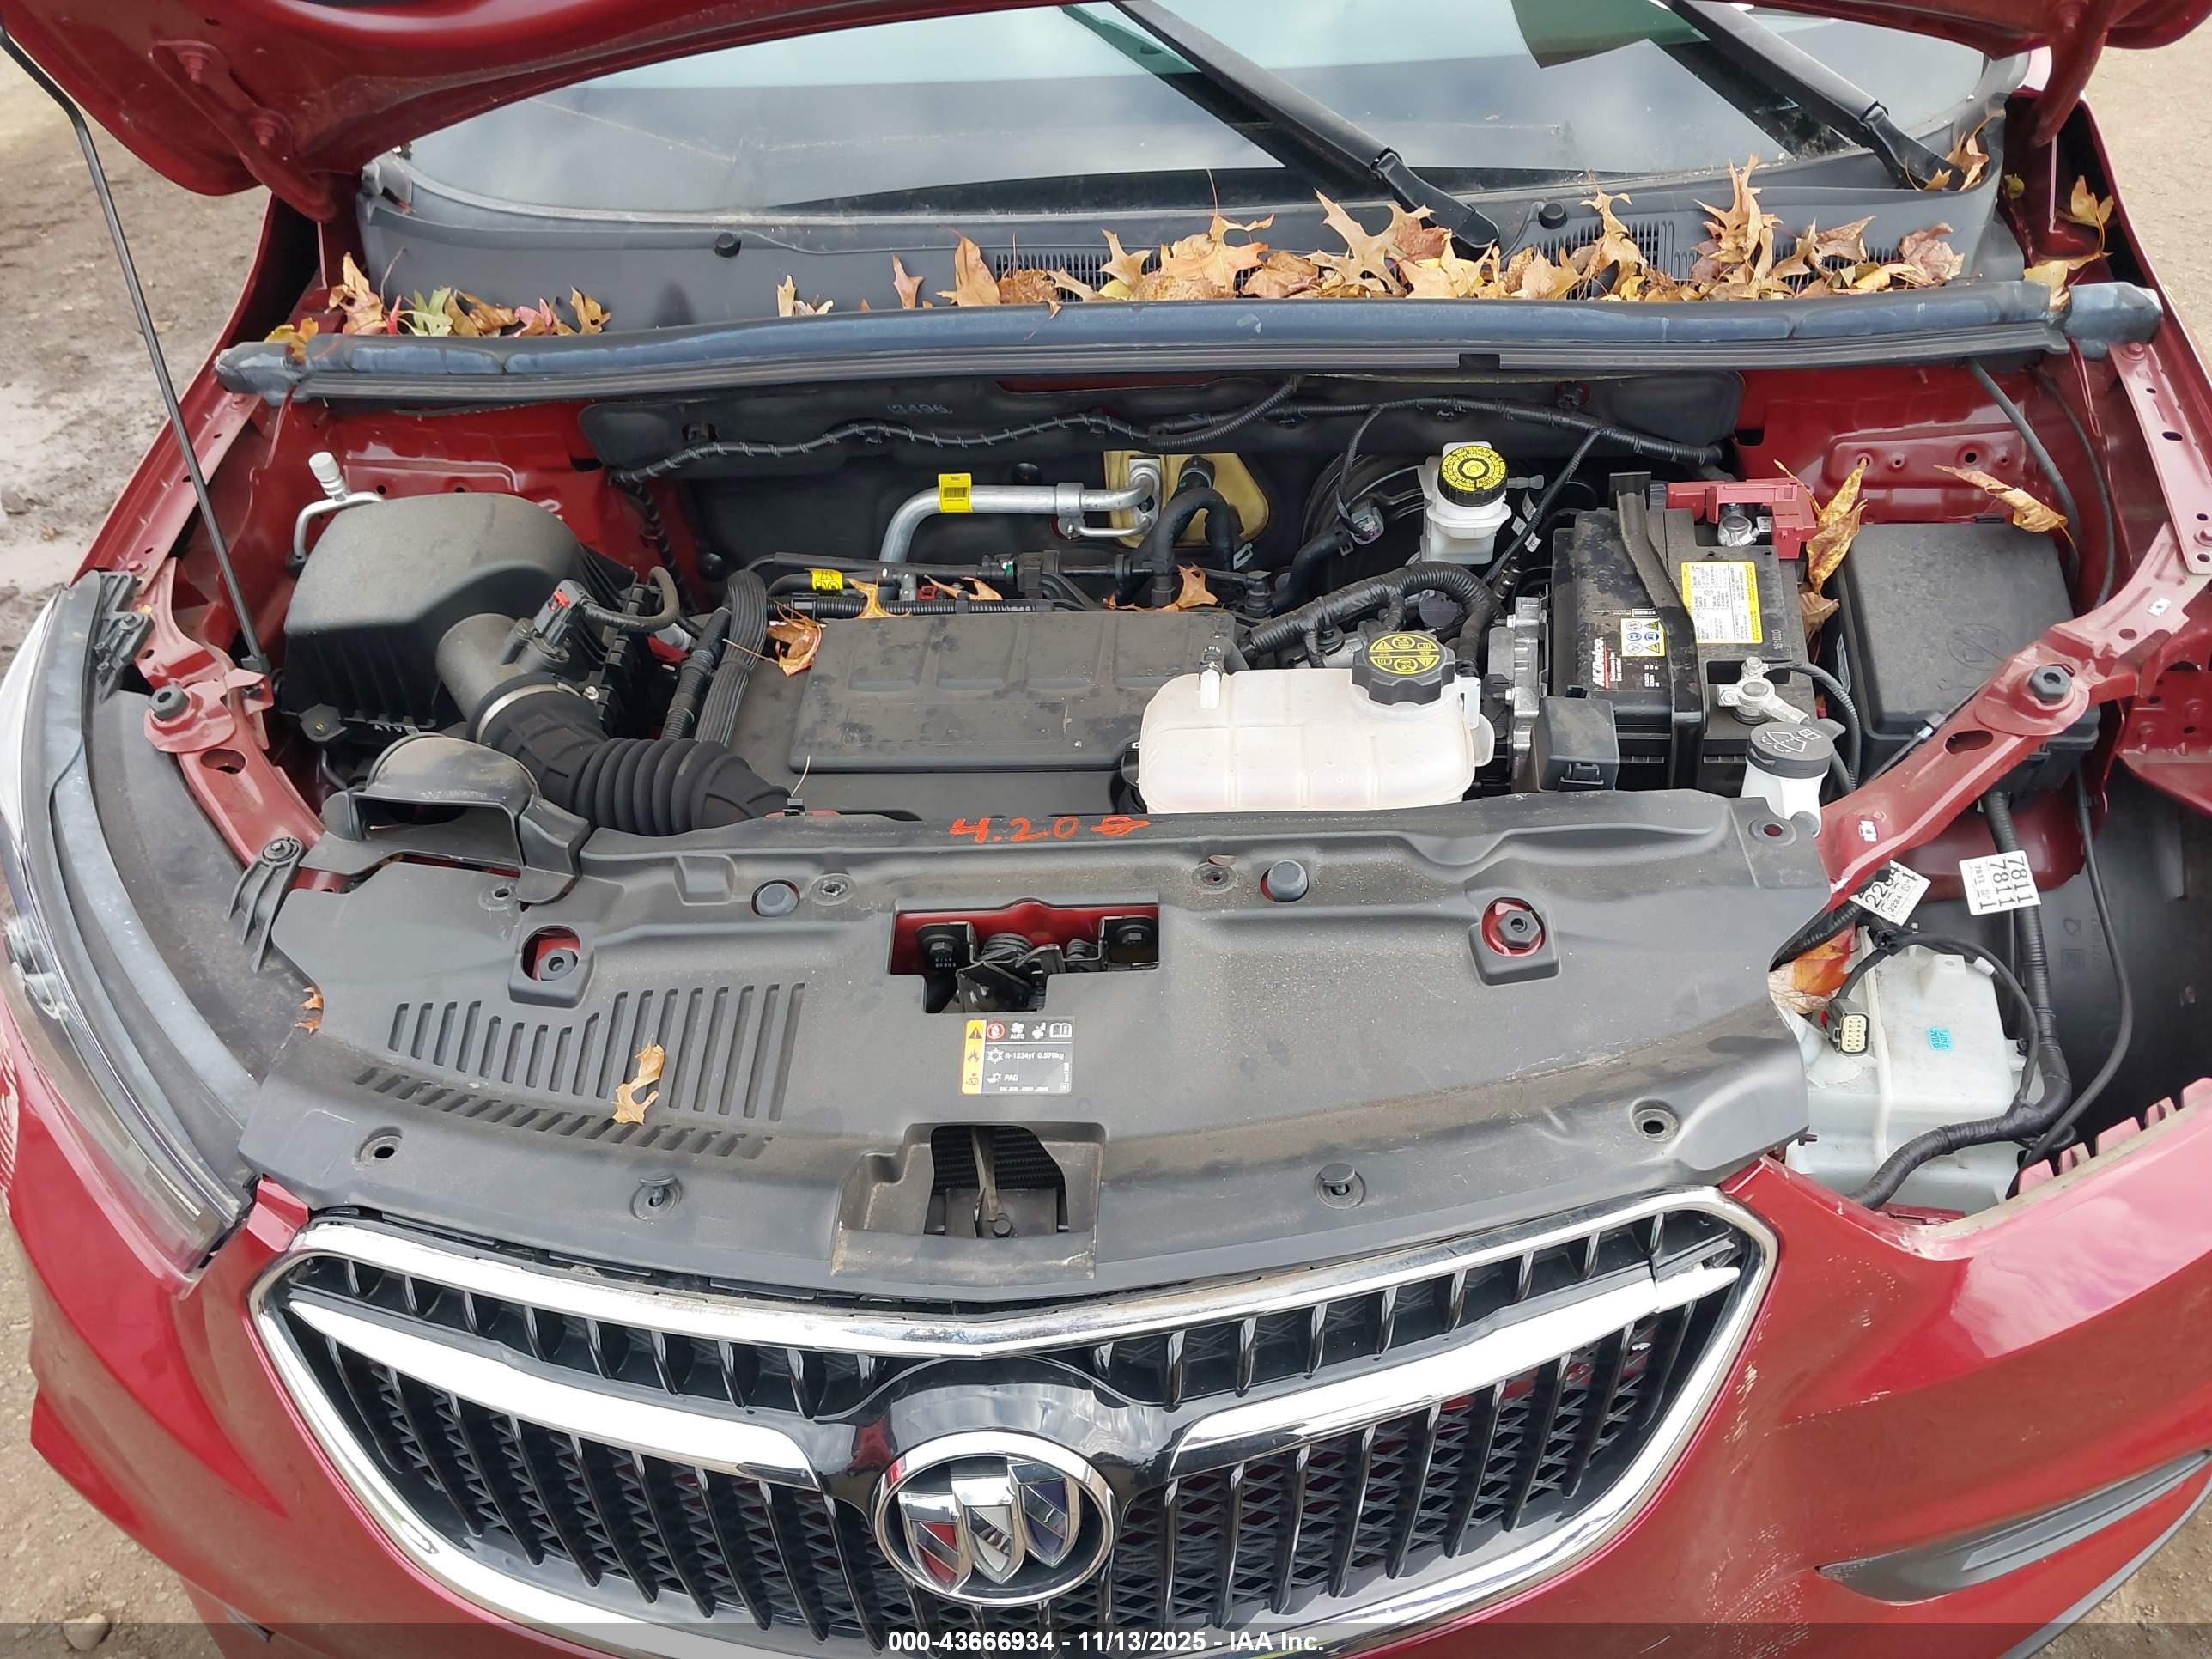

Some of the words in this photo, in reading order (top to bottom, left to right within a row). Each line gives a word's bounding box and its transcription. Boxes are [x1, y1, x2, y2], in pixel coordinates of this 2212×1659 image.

[1592, 637, 1605, 688] ACDelco
[1990, 859, 2016, 907] 7811
[2008, 855, 2033, 903] 7811
[1005, 1052, 1036, 1060] R-1234yf
